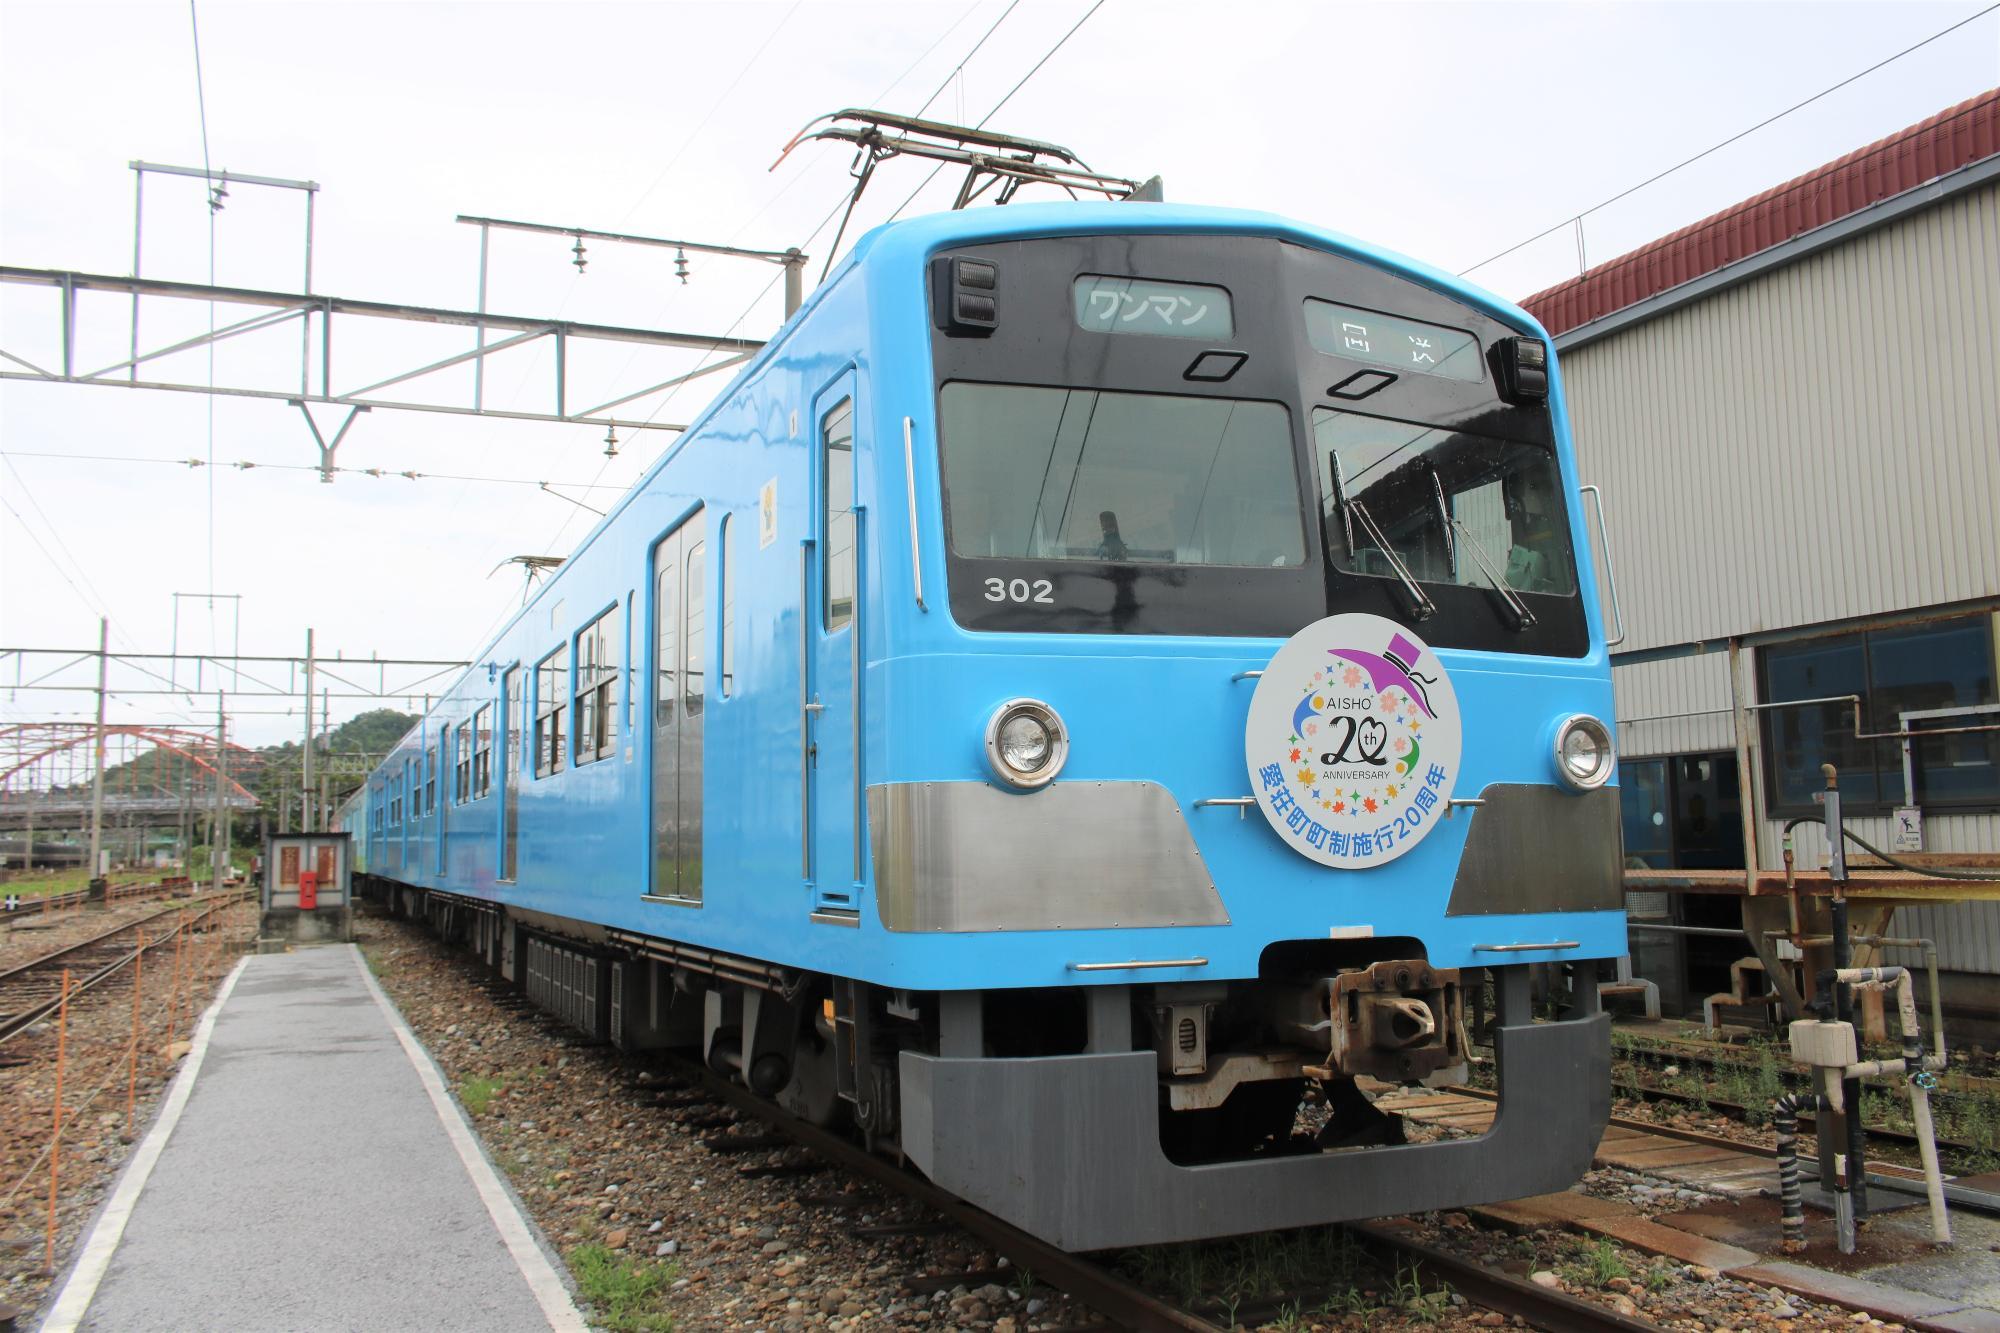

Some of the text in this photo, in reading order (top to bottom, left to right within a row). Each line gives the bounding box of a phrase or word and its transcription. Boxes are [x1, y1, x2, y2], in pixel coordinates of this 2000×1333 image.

[1090, 290, 1207, 326] ワンマン
[984, 577, 1054, 604] 302
[1326, 697, 1372, 710] AISHO
[1322, 770, 1391, 780] ANNIVERSARY
[1258, 761, 1446, 858] 愛荘町町制施行20周年
